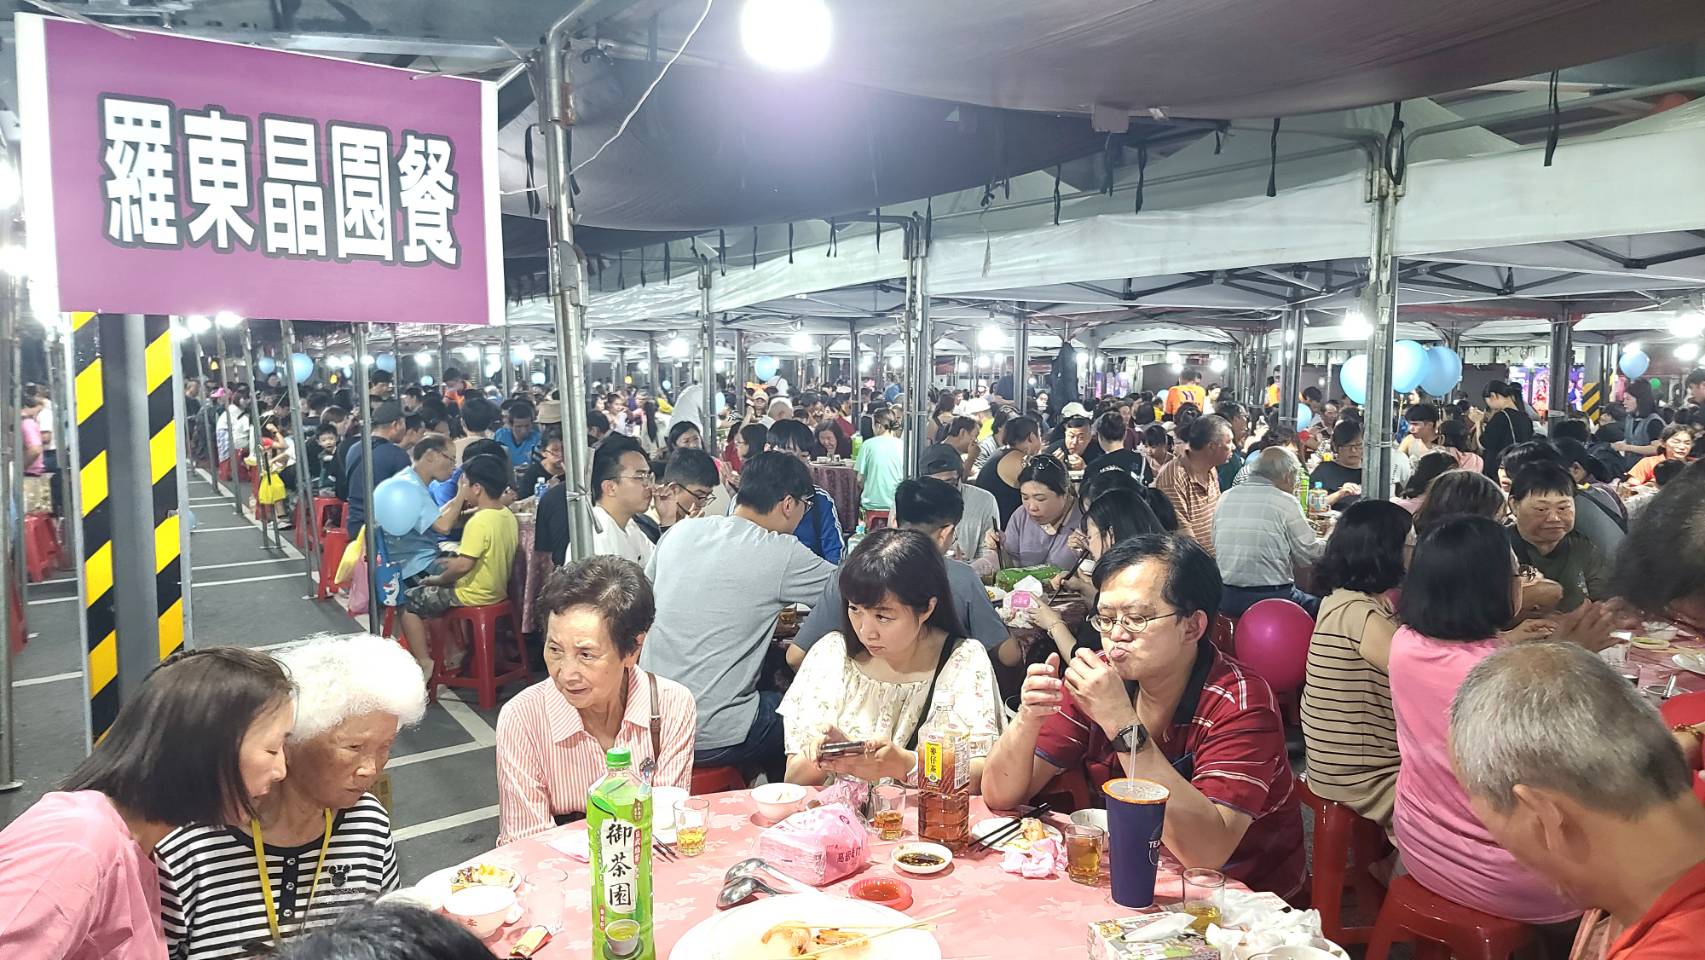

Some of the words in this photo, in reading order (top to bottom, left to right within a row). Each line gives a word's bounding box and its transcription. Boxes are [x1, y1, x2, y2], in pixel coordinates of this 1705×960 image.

[100, 94, 459, 267] 羅東晶園餐
[606, 823, 633, 906] 御茶園
